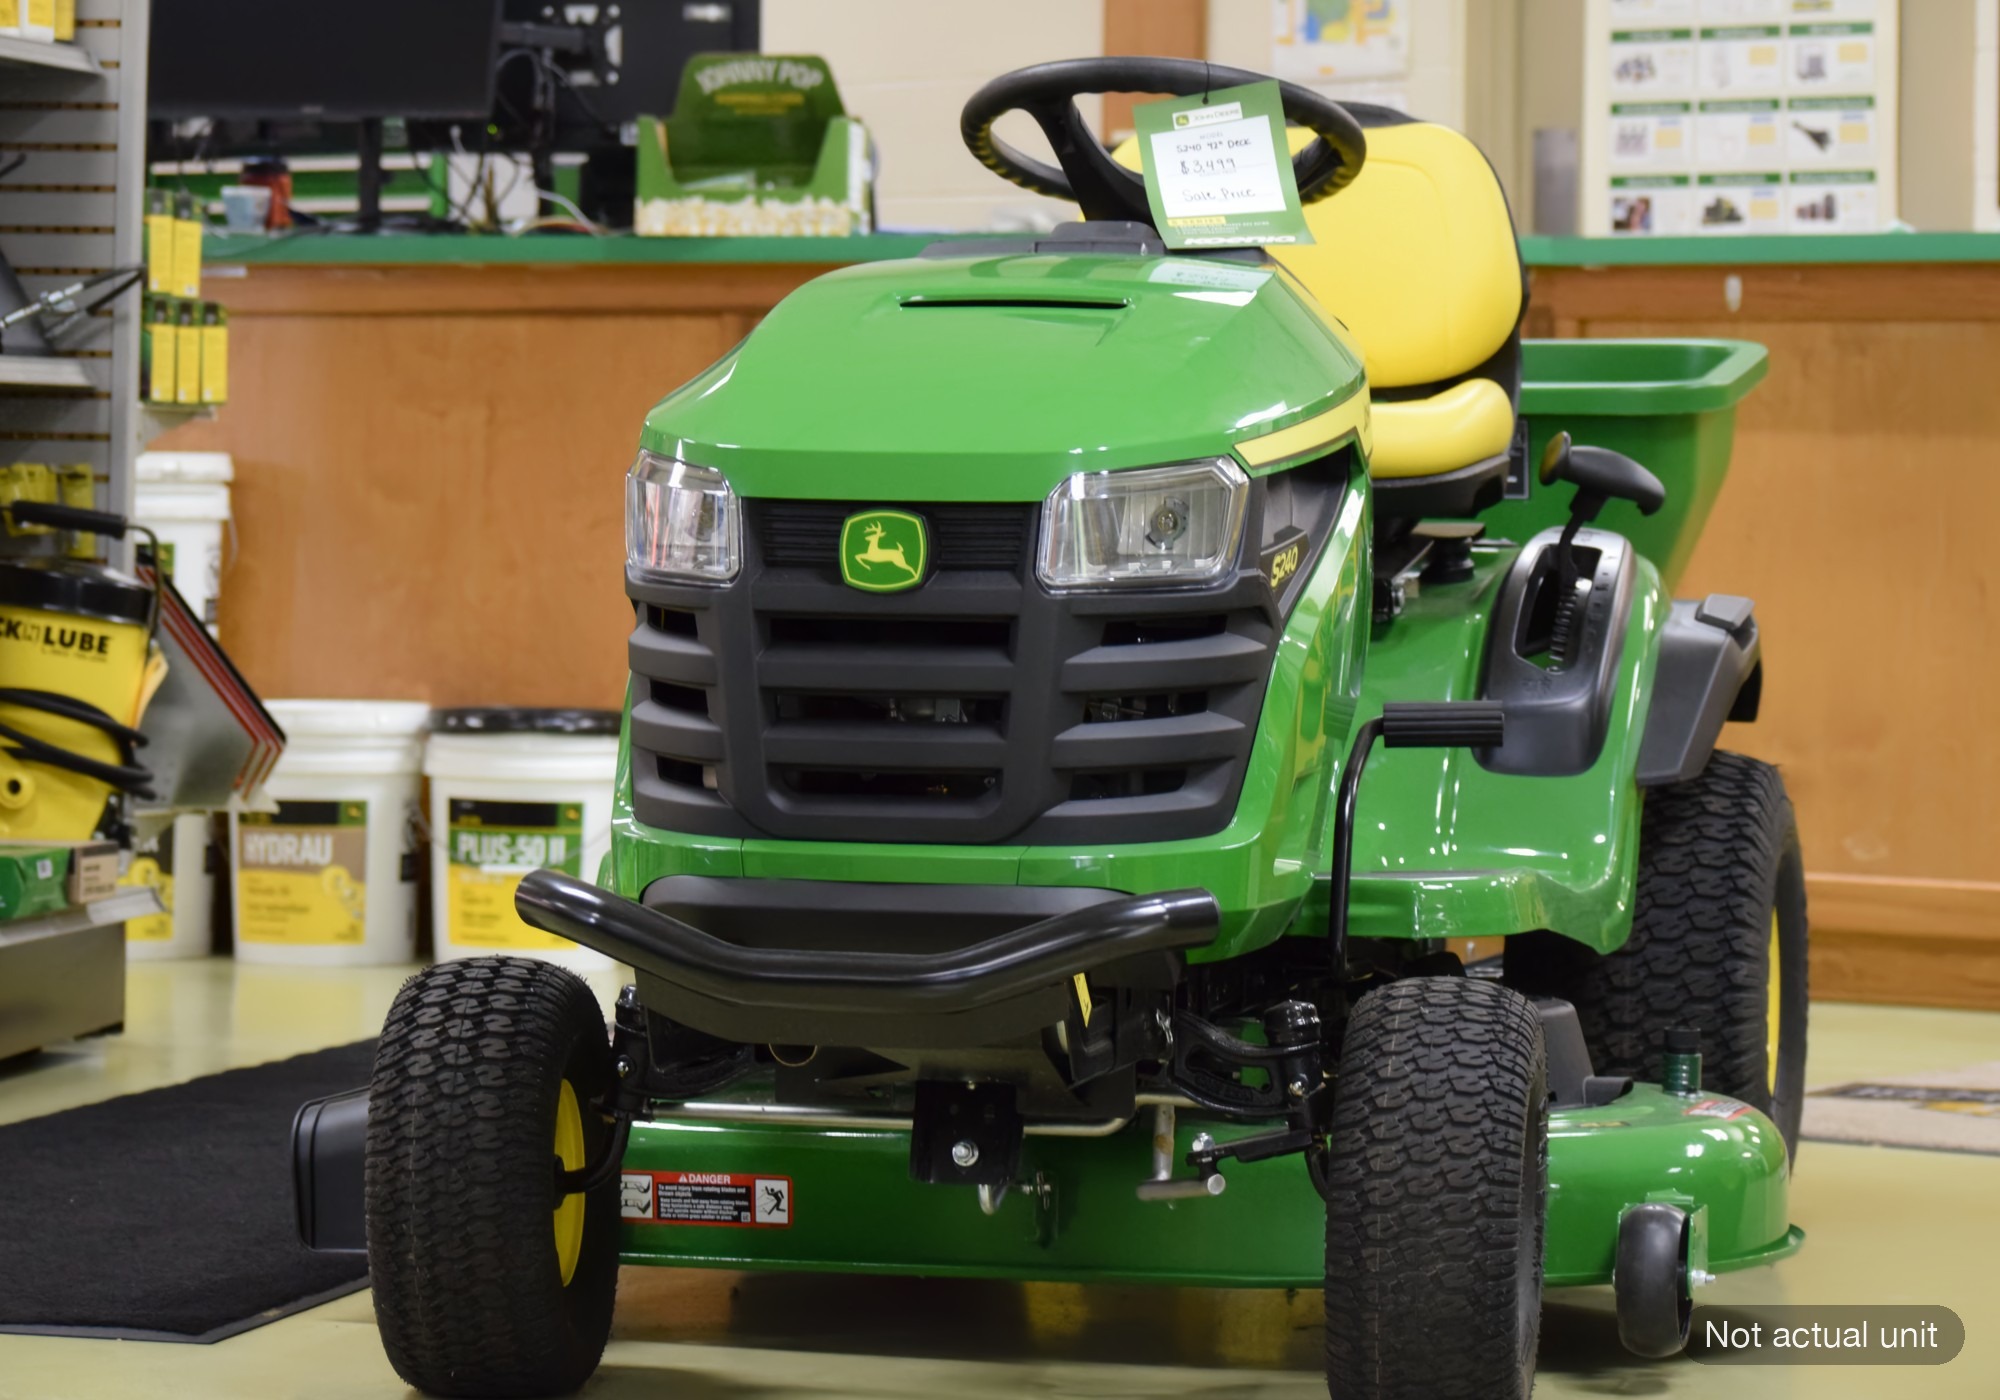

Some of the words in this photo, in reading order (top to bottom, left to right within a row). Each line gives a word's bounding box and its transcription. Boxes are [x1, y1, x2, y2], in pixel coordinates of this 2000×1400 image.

[694, 60, 778, 95] JOHNNY
[777, 60, 824, 90] POP
[1182, 188, 1216, 202] Sale
[1220, 187, 1256, 200] Price
[1271, 543, 1299, 588] S240
[43, 625, 111, 654] LUBE
[243, 831, 333, 866] HYDRAU
[457, 831, 547, 866] PLUS-50
[688, 1173, 731, 1185] DANGER
